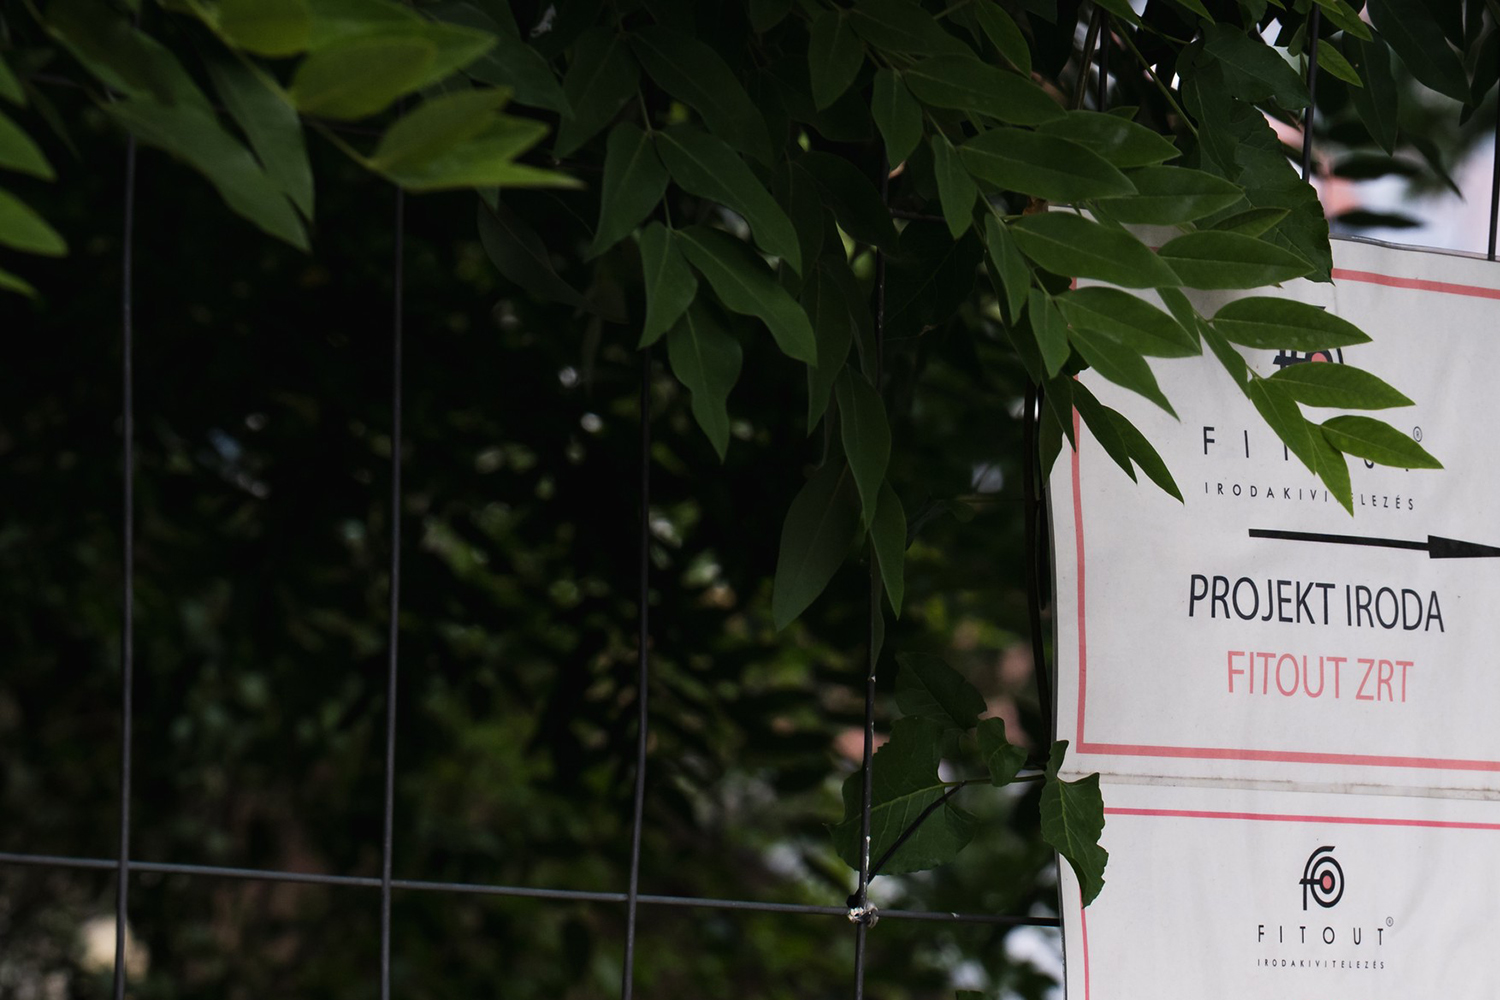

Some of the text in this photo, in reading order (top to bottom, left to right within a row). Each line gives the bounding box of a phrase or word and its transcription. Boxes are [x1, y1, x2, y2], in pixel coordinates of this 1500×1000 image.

[1205, 482, 1414, 510] IRODAKIVILEZÉS
[1189, 574, 1445, 632] PROJEKT IRODA
[1227, 650, 1414, 703] FITOUT ZRT
[1258, 959, 1384, 970] IRODAKIVITELEZÉS
